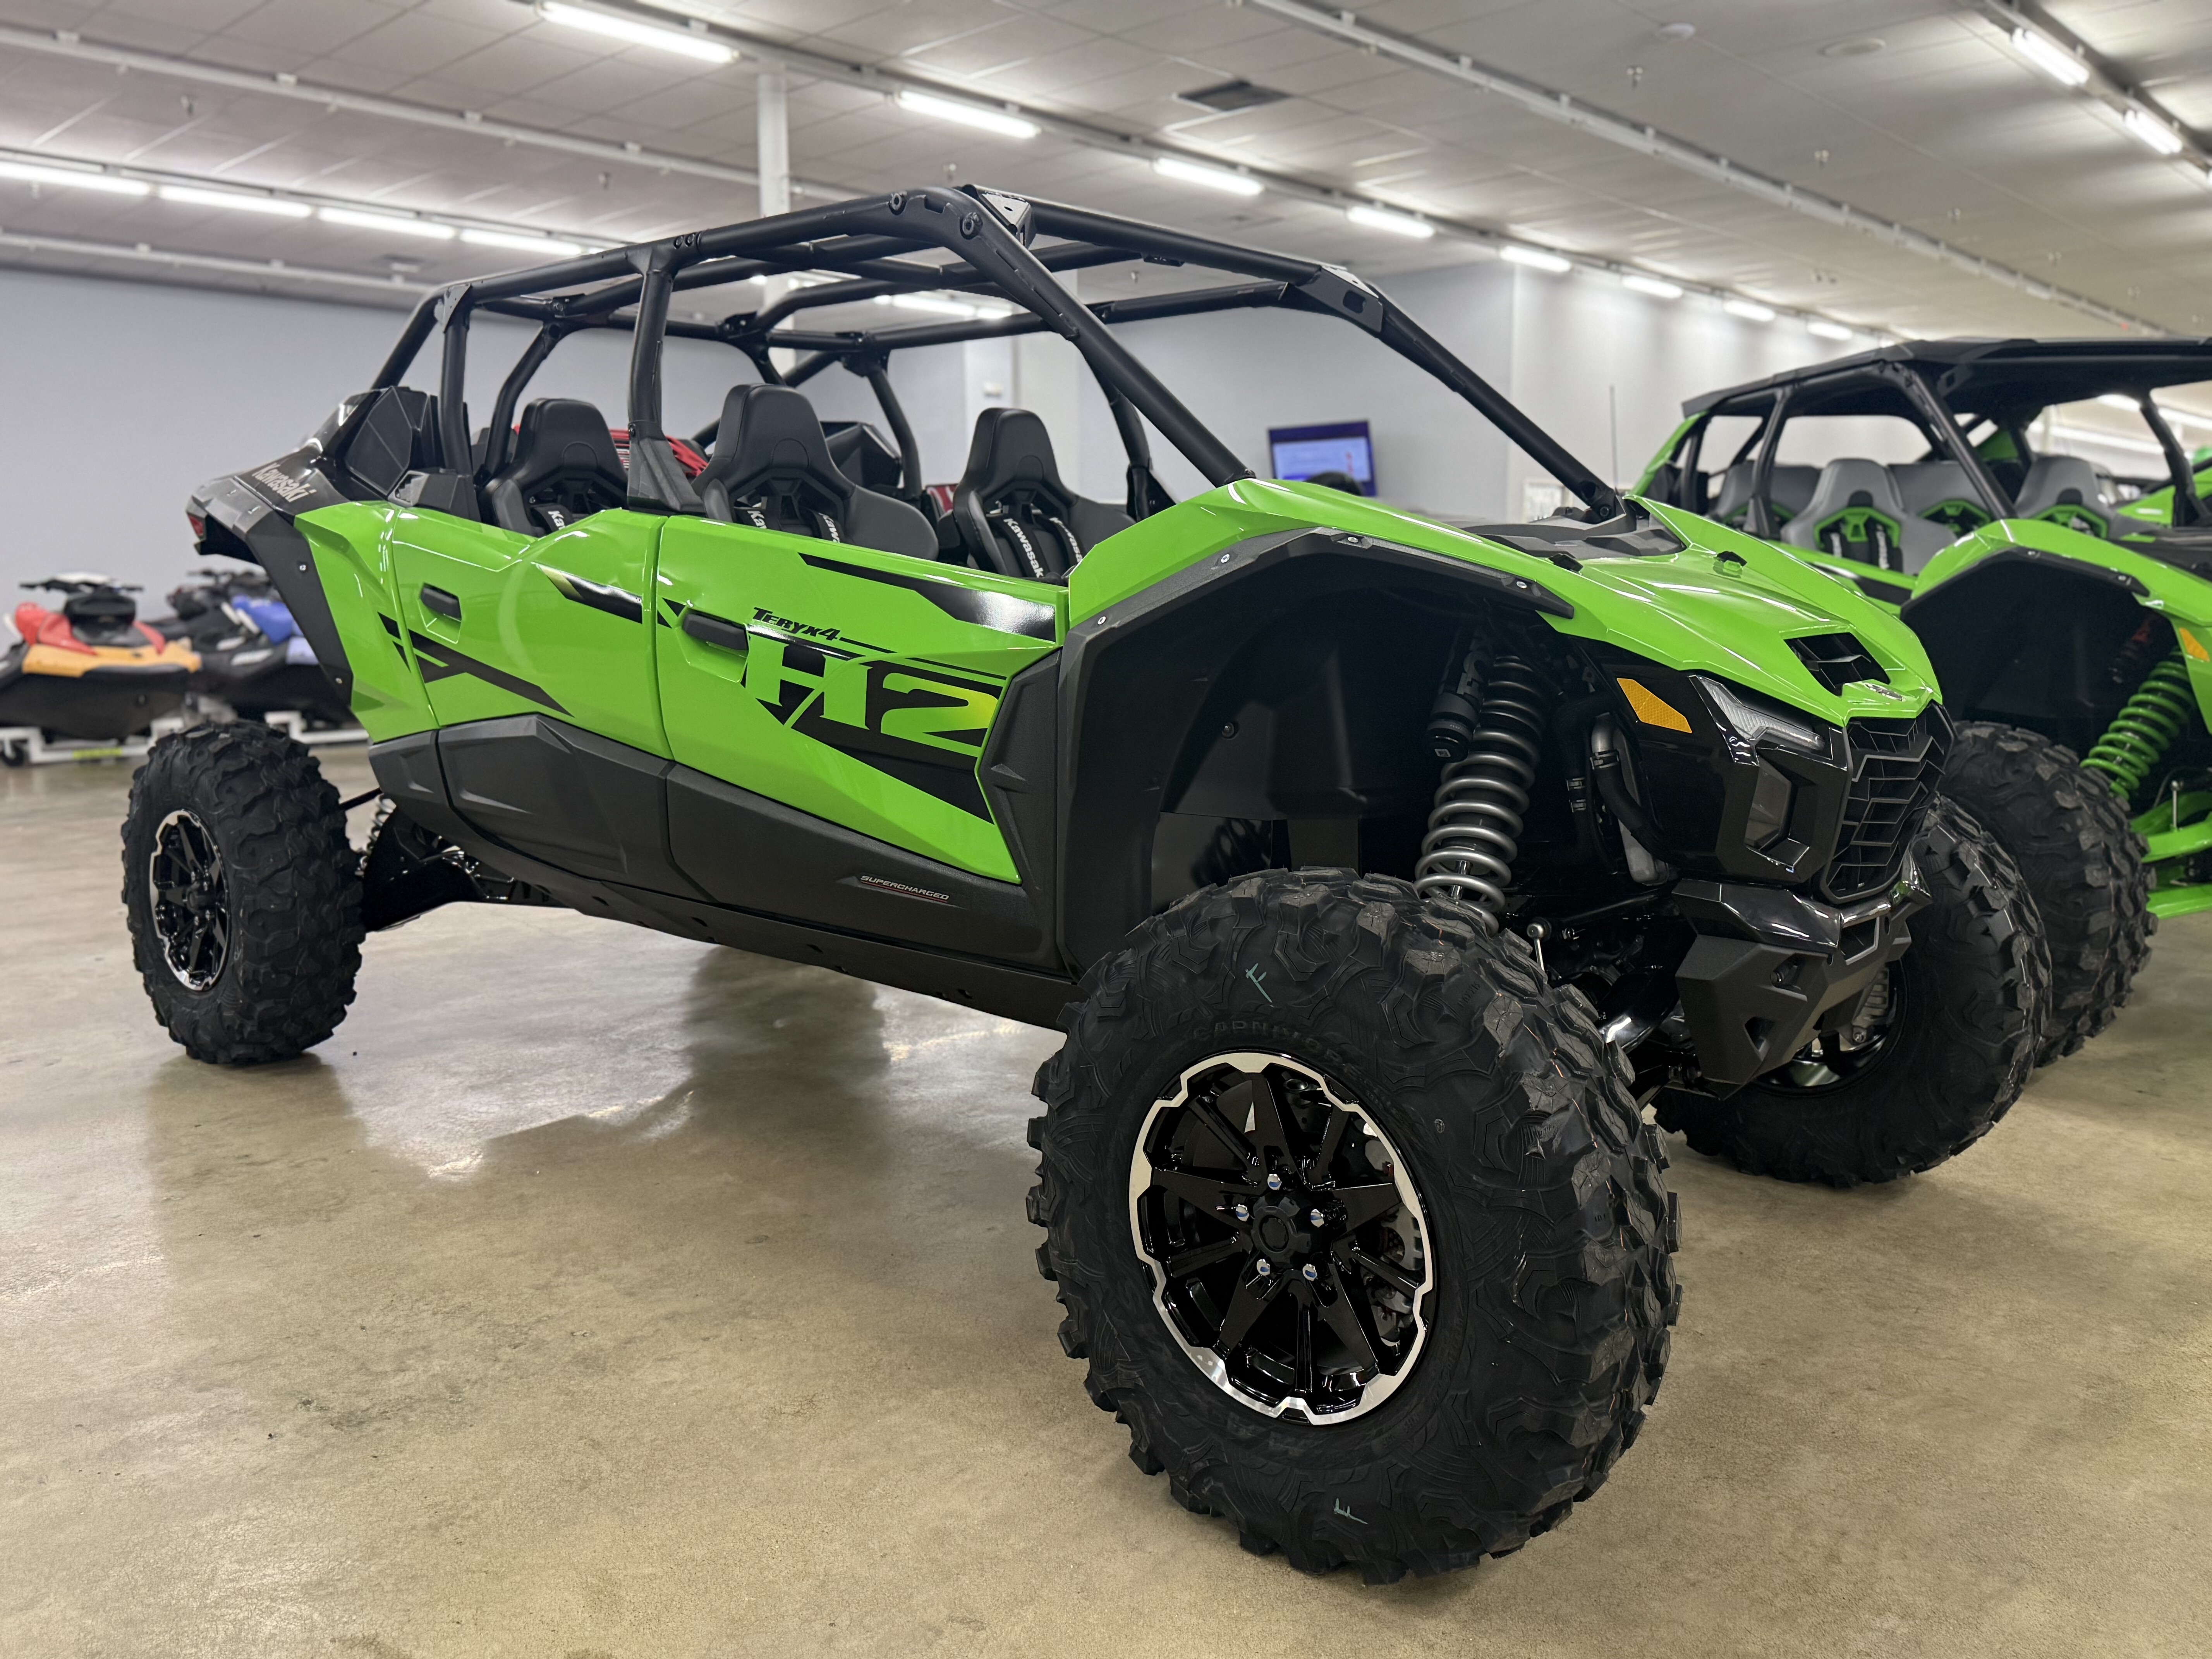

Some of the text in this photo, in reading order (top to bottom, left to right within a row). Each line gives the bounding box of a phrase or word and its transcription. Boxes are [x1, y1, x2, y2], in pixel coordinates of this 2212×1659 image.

[252, 463, 317, 502] Kawasaki
[548, 510, 566, 530] Ka
[747, 510, 767, 529] Ka
[745, 632, 998, 757] H2
[860, 875, 949, 900] SUPERCHARGED
[1245, 963, 1273, 1003] F
